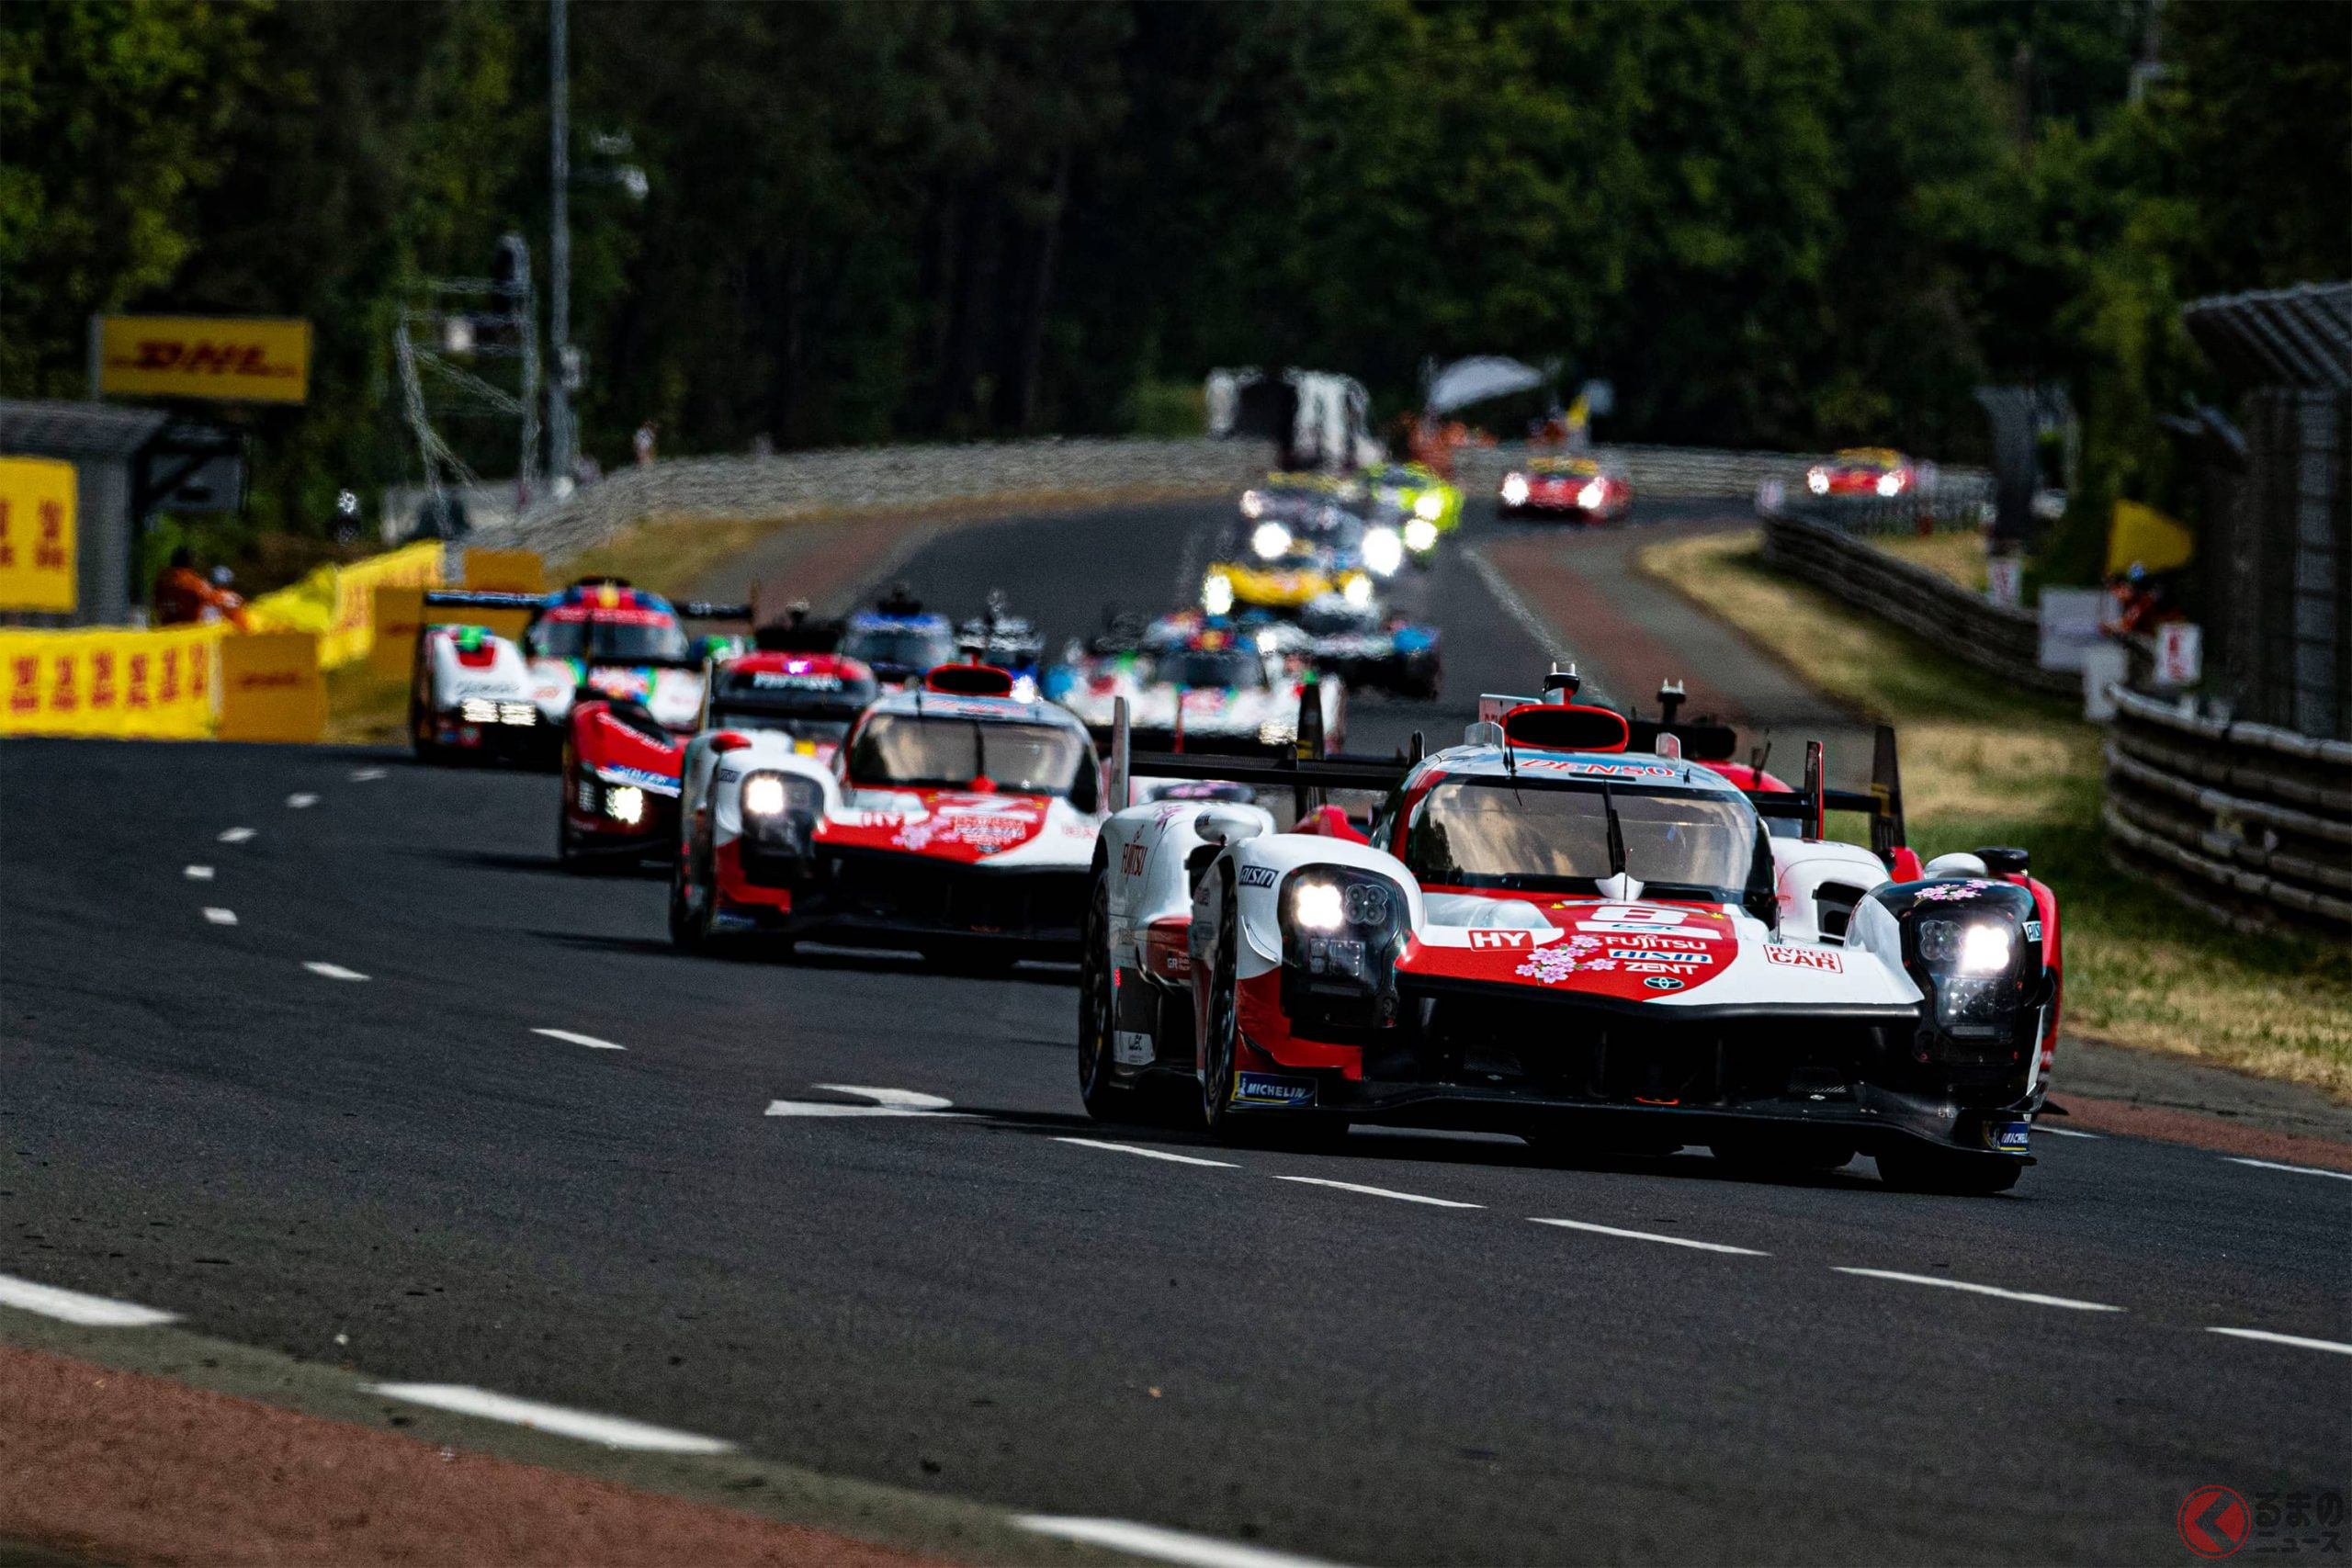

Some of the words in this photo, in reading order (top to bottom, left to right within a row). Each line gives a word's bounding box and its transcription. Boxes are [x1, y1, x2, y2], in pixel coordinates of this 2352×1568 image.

[1521, 759, 1676, 777] DENSO
[1122, 842, 1148, 877] FUJITSU
[1472, 931, 1527, 948] HY
[1604, 935, 1707, 950] FUJITSU
[1612, 950, 1708, 962] AISIN
[1771, 952, 1836, 971] CAR
[1623, 962, 1699, 975] ZENT
[1247, 1083, 1306, 1099] MICHELIN
